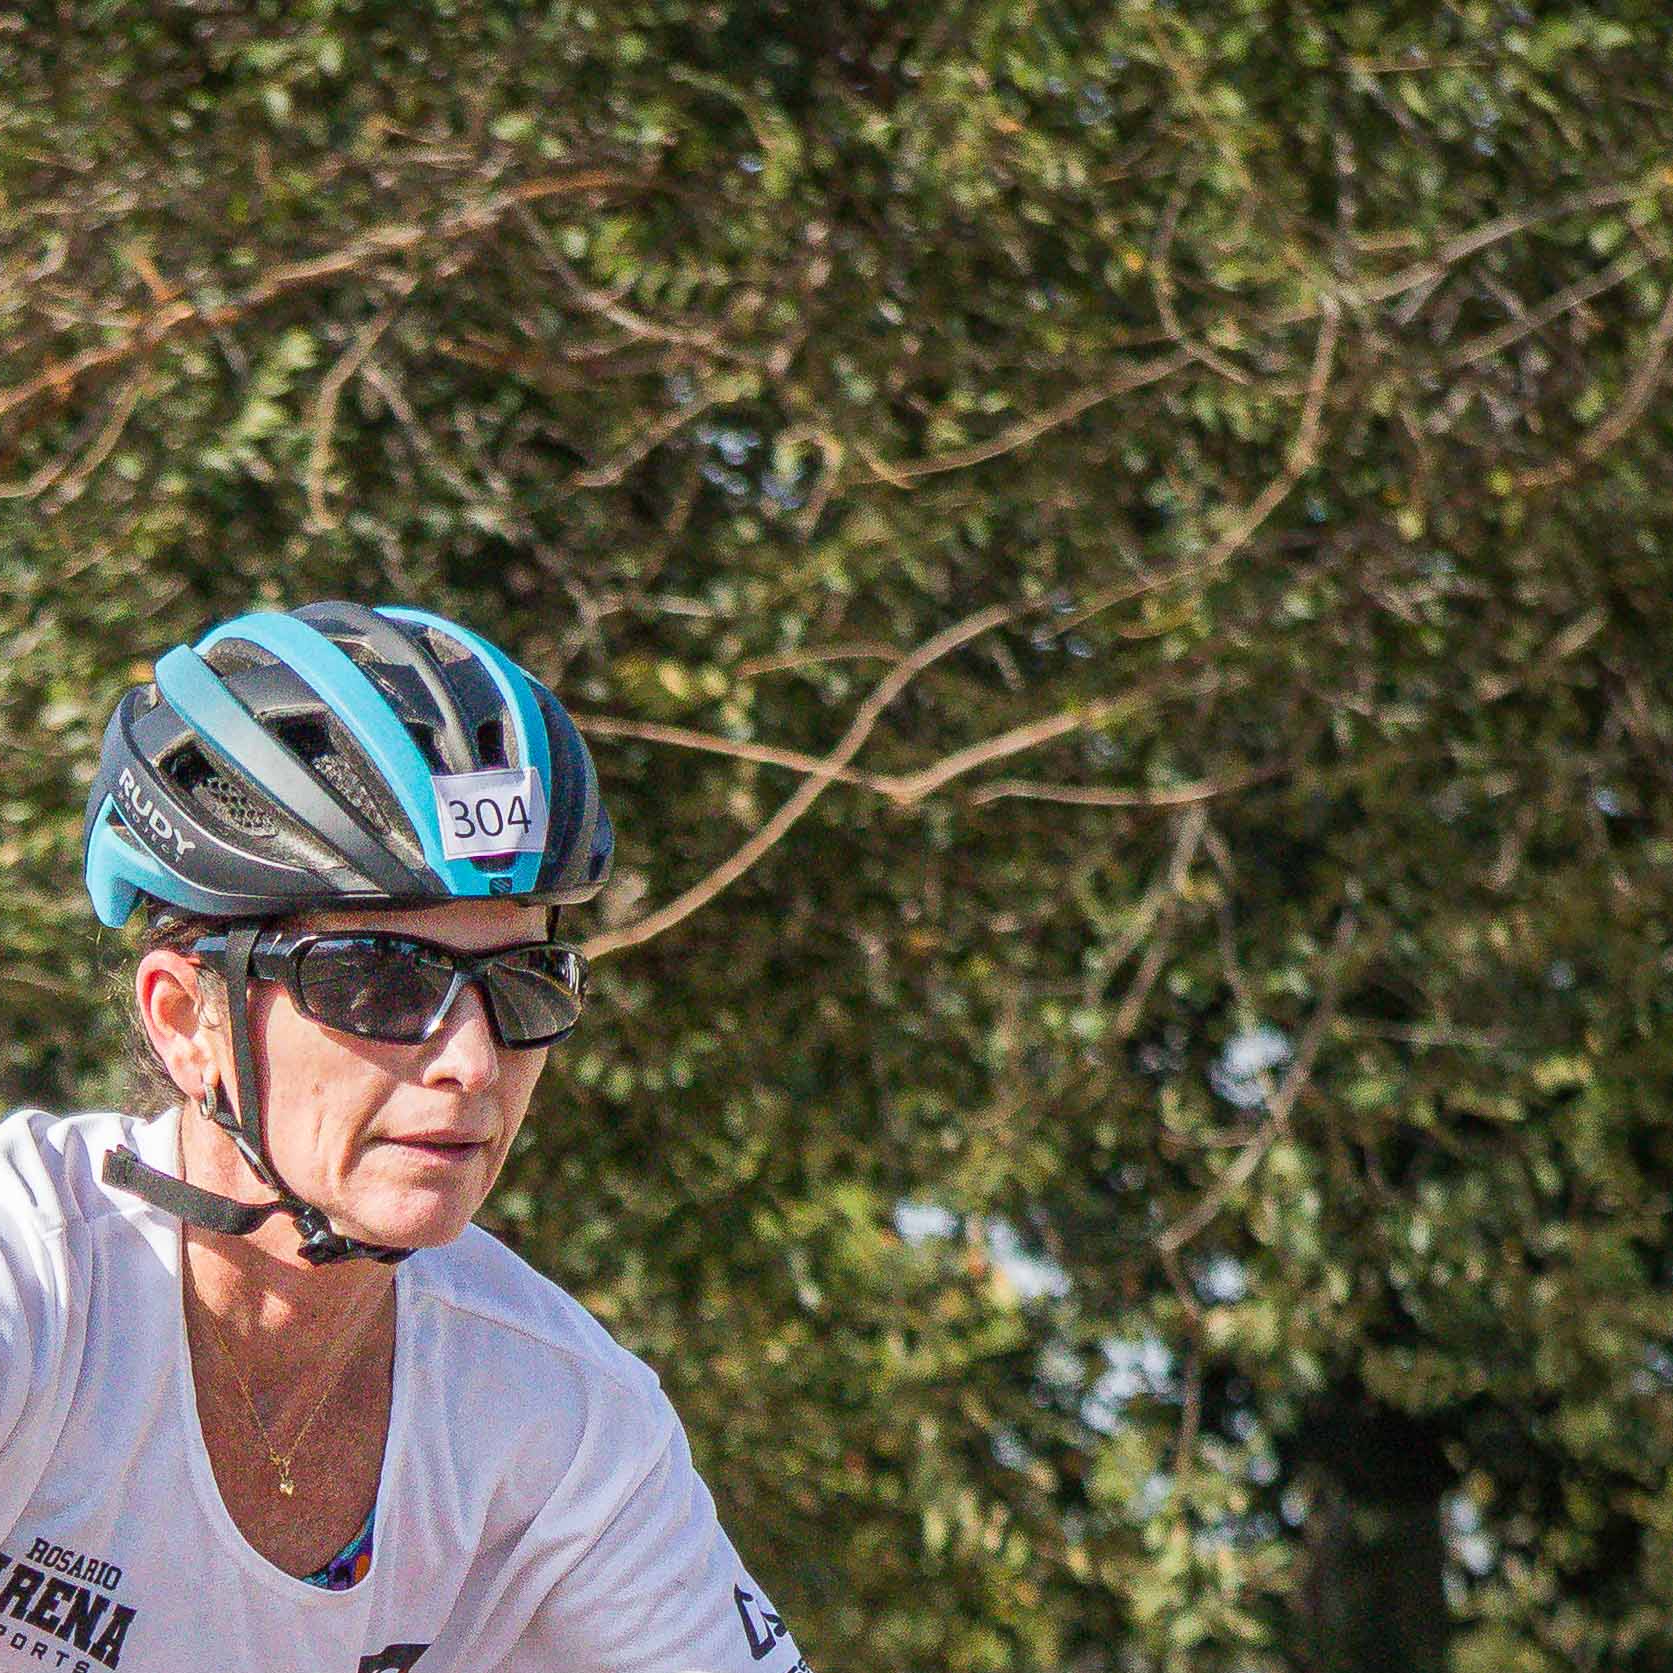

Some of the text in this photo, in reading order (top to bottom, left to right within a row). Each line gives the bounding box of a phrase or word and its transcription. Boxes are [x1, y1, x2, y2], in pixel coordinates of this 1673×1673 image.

[118, 767, 196, 855] RUDY
[448, 795, 532, 838] 304
[25, 1536, 123, 1591] ROSARIO
